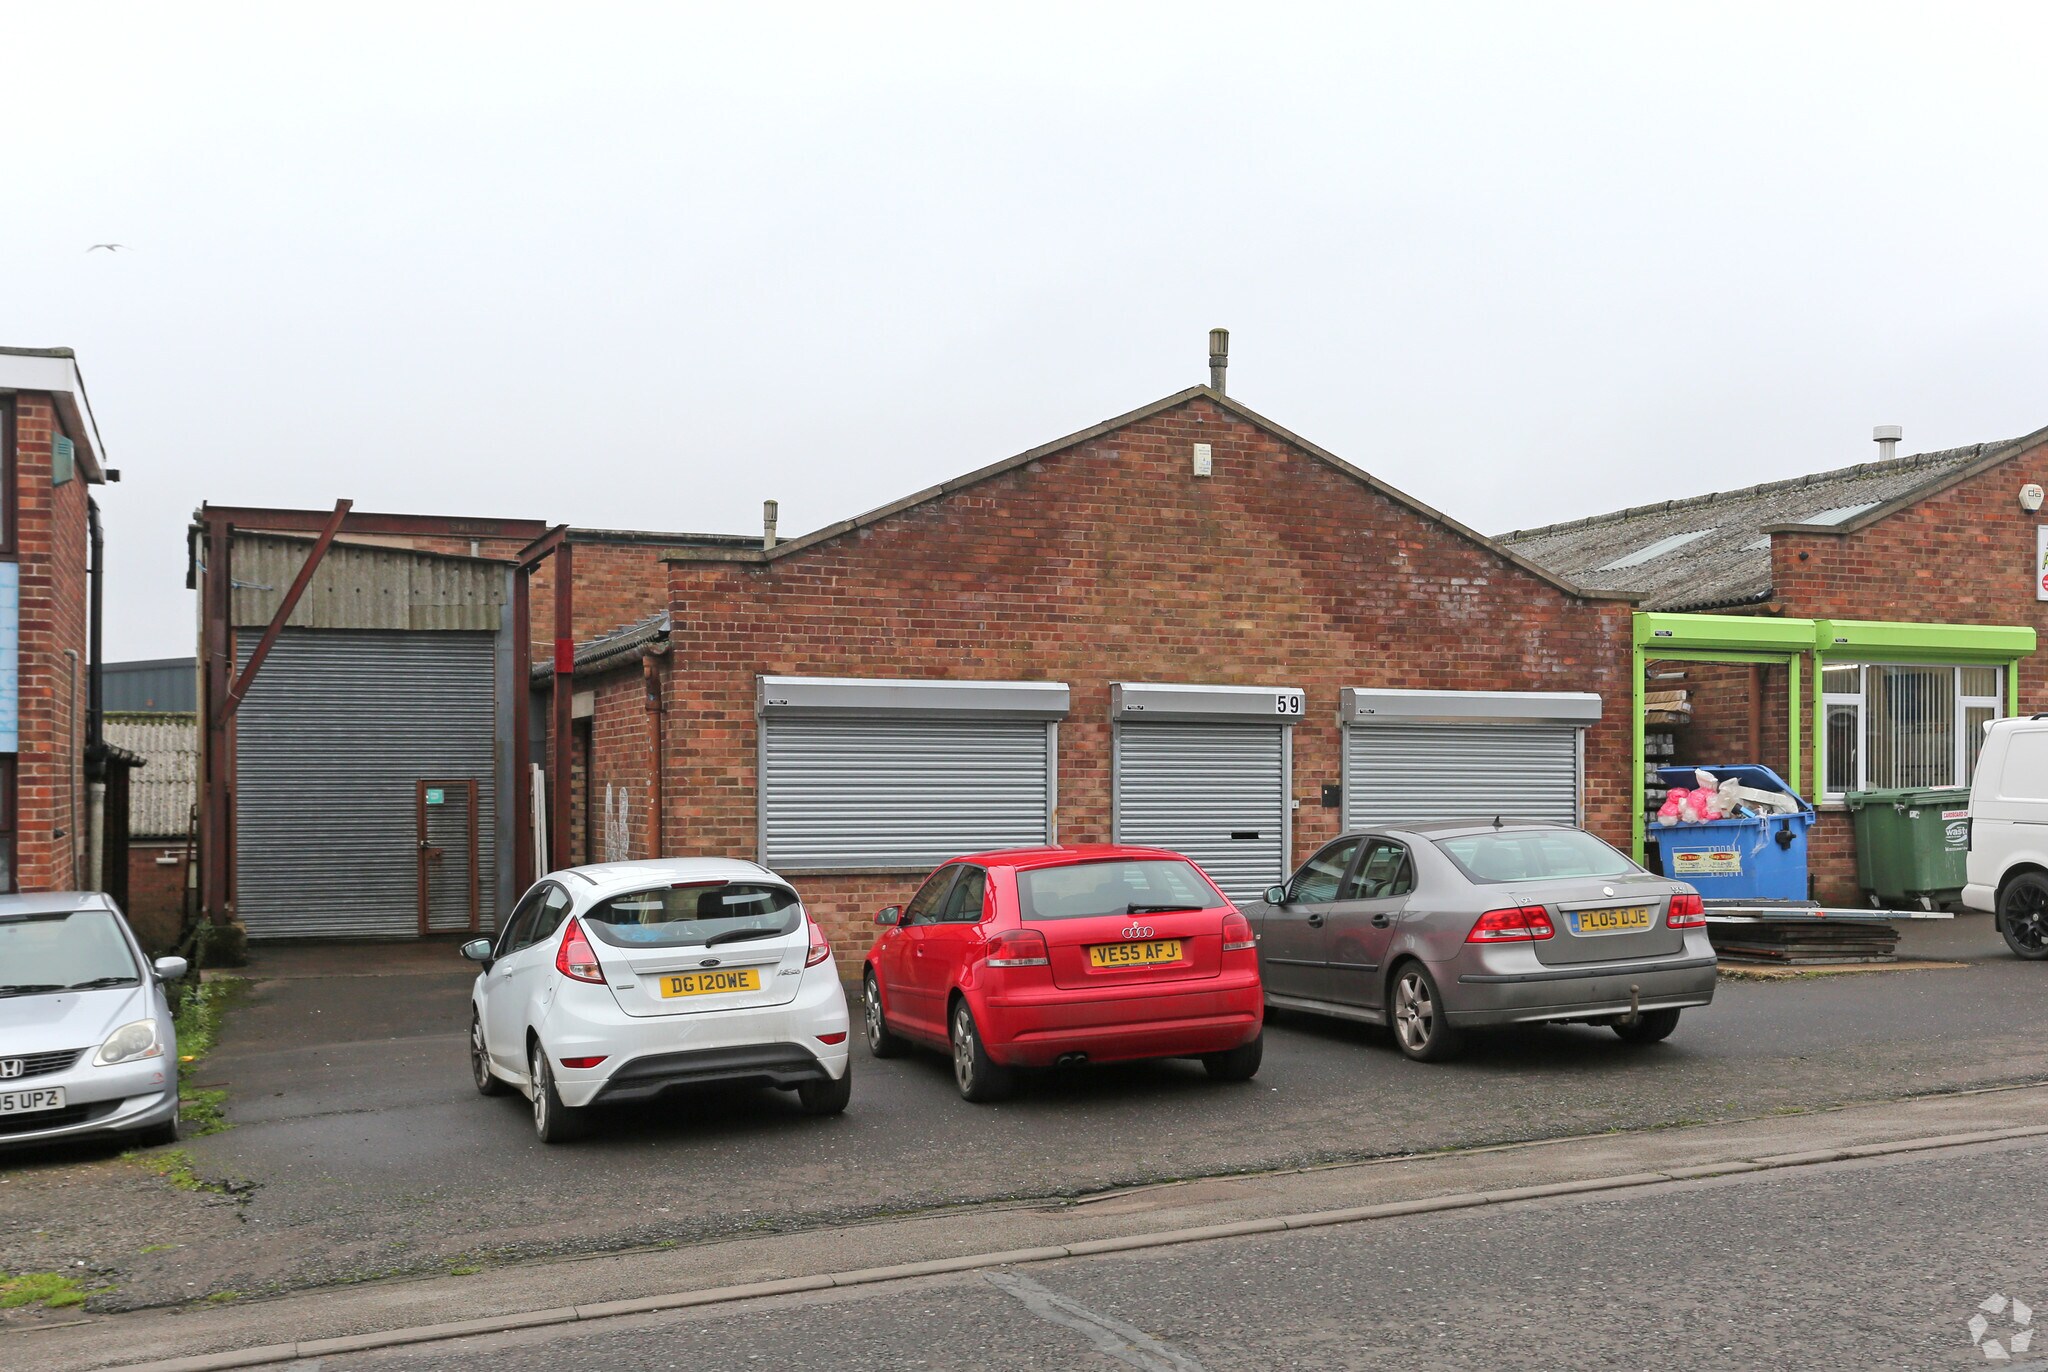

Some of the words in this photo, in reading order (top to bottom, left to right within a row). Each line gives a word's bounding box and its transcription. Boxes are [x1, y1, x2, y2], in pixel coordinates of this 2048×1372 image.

[1277, 695, 1299, 714] 59
[1580, 910, 1618, 928] FL05
[1621, 908, 1648, 925] DJE
[1097, 945, 1140, 963] VE55
[20, 1090, 57, 1108] UPZ
